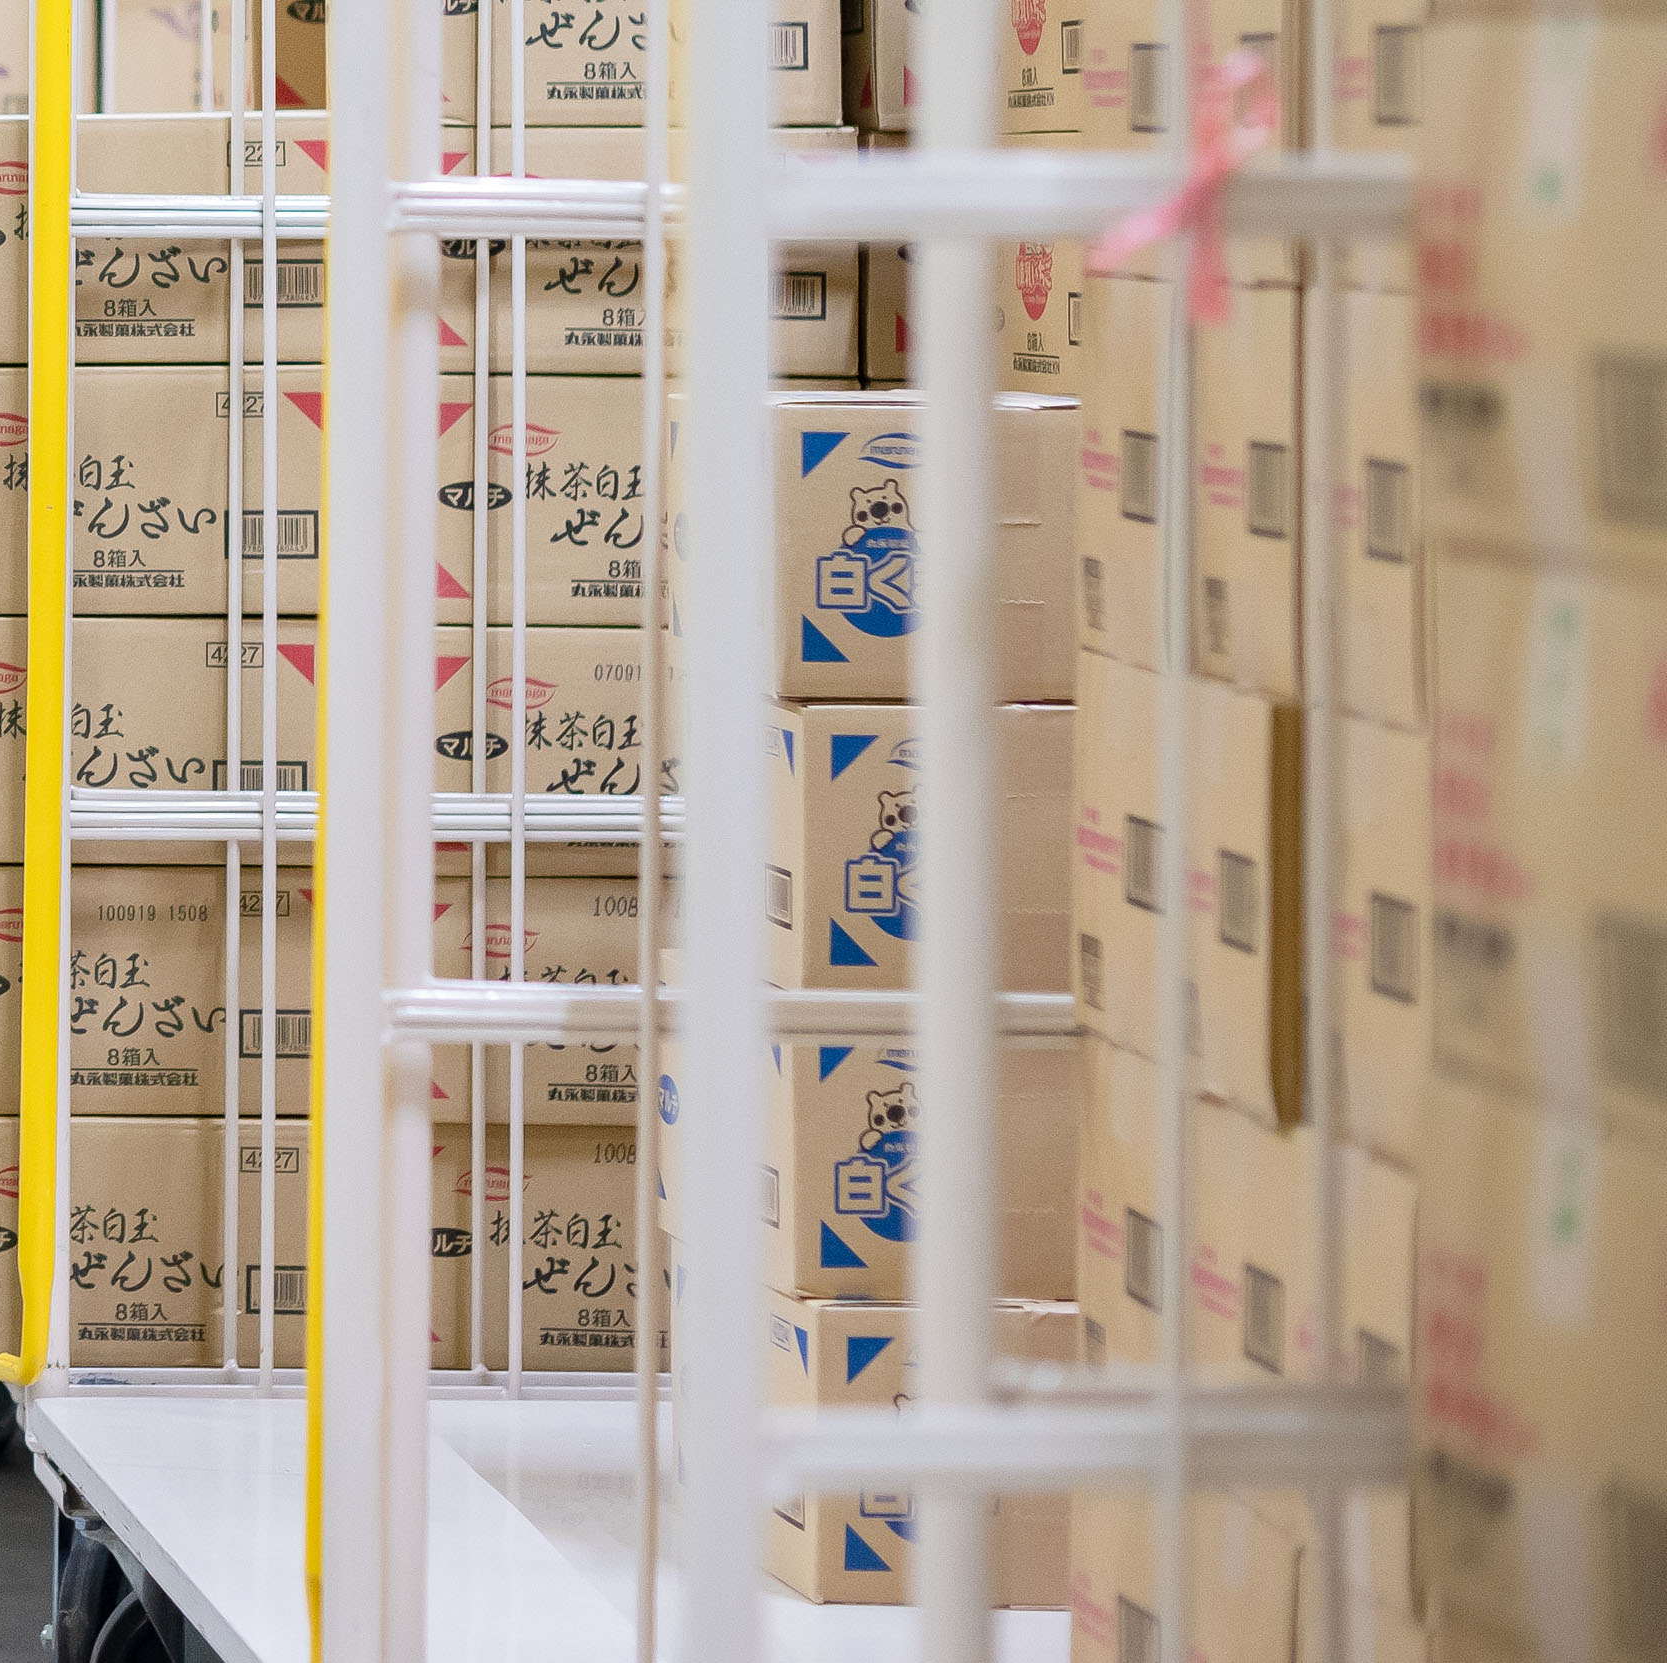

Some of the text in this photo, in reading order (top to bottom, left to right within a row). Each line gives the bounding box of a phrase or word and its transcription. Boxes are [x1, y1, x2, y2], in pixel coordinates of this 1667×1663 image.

[584, 62, 636, 79] 8箱入
[544, 256, 639, 297] ぜん
[104, 299, 156, 317] 8箱入
[76, 323, 195, 336] 永製菓株式会社
[3, 453, 135, 492] 抹白玉
[73, 497, 217, 539] んざい
[93, 549, 146, 567] 8箱入
[72, 745, 206, 789] んざい
[98, 904, 208, 922] 100919 1508
[108, 1048, 160, 1067] 8箱入
[586, 1064, 636, 1082] 8箱入
[116, 1302, 168, 1321] 8箱入
[578, 1309, 630, 1327] 8箱入
